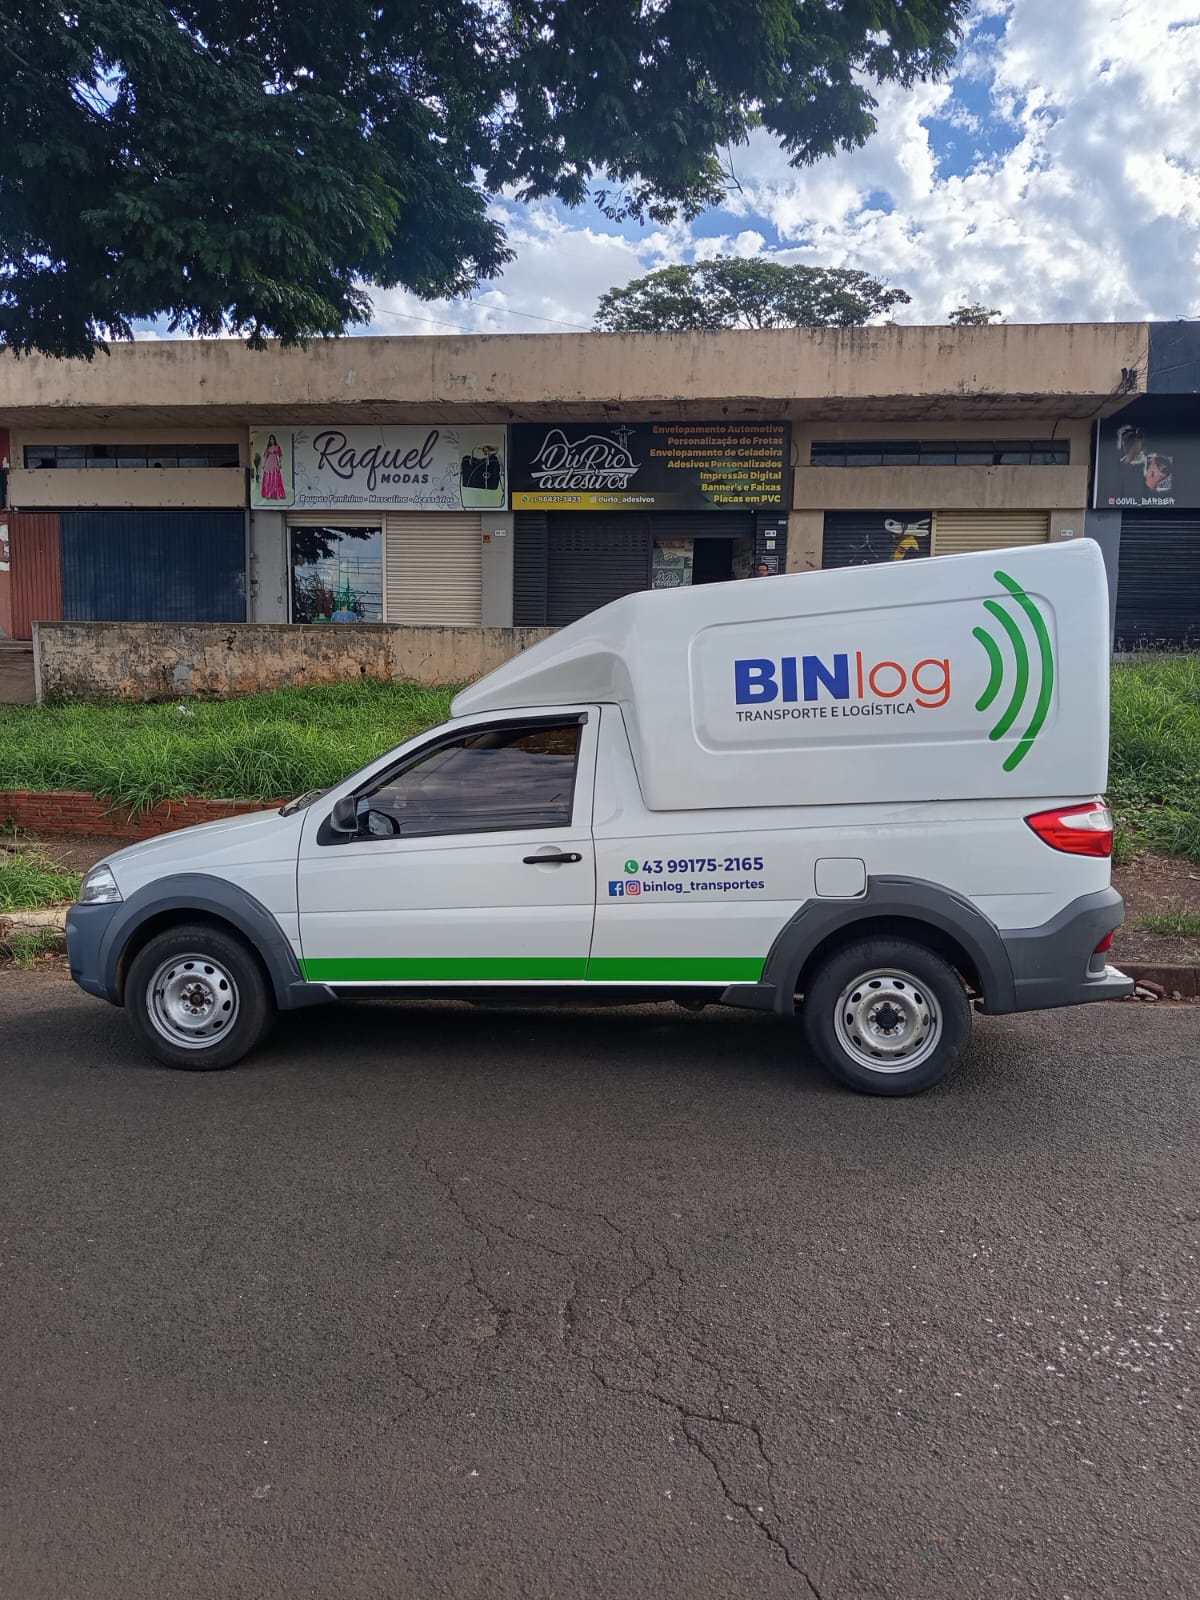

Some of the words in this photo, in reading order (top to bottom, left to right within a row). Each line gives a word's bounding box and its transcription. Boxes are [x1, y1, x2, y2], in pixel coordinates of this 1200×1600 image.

[652, 425, 726, 435] Envelopamento
[727, 424, 784, 433] Automotivo
[667, 437, 738, 446] Personalização
[739, 437, 751, 445] de
[752, 437, 784, 445] Frotas
[649, 448, 723, 458] Envelopamento
[724, 448, 737, 456] de
[737, 448, 783, 456] Geladeira
[313, 430, 439, 491] Raquel
[667, 460, 709, 468] Adesivos
[710, 460, 782, 468] Personalizados
[381, 474, 428, 484] MODAS
[539, 467, 630, 489] adesivos
[699, 471, 749, 480] Impressão
[750, 471, 782, 481] Digital
[701, 483, 743, 491] Banner's
[750, 483, 781, 491] Faixas
[713, 495, 744, 503] Placas
[761, 495, 781, 503] PVC
[734, 651, 951, 709] BINlog
[736, 707, 827, 722] TRANSPORTE
[831, 706, 839, 718] E
[842, 702, 916, 717] LOGÍSTICA
[642, 860, 664, 874] 43
[667, 857, 764, 873] 99175-2165
[643, 879, 765, 894] binlog_transportes
